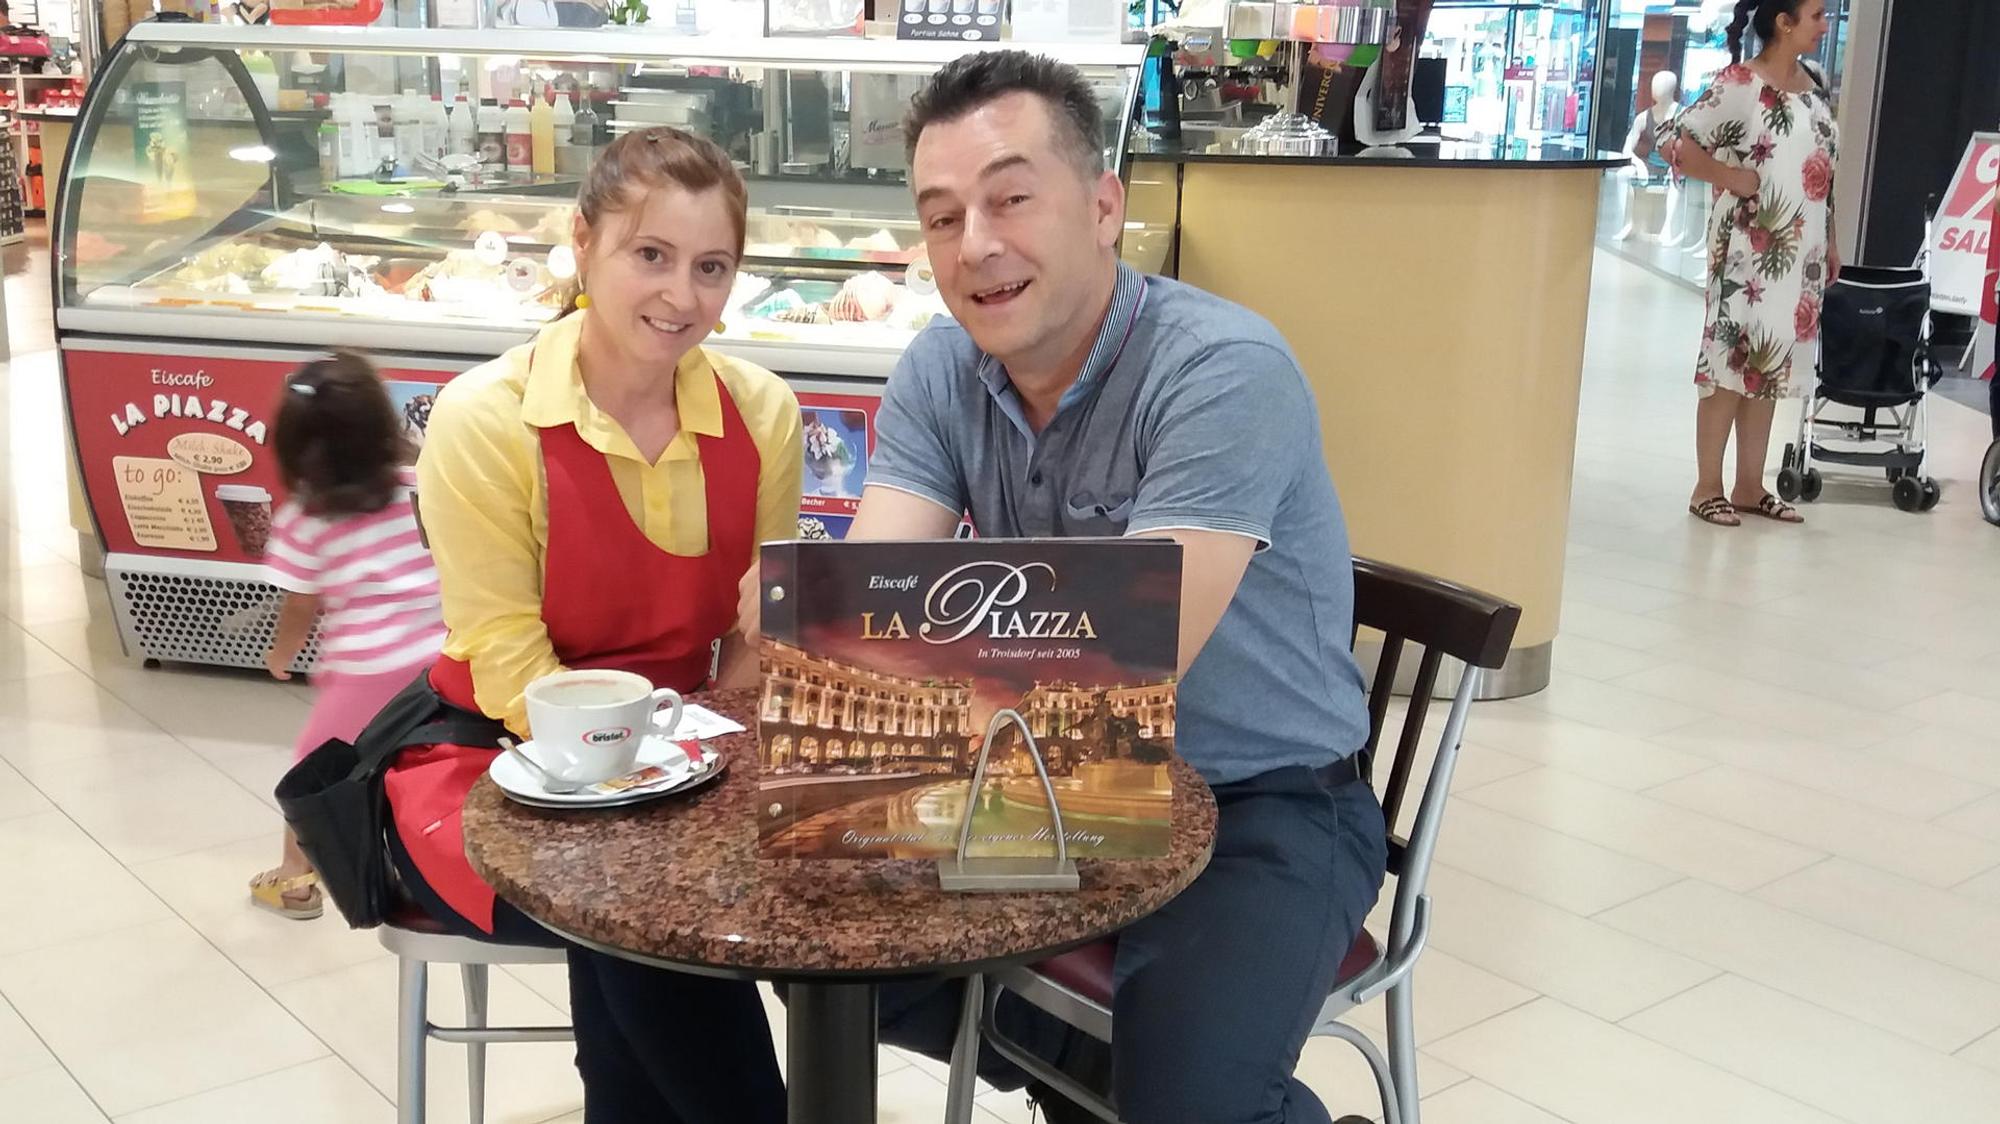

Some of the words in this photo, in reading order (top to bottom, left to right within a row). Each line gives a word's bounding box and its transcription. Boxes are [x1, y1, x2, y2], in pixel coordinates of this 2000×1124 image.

[1939, 227, 1988, 256] SAL
[151, 369, 214, 390] Eiscafe
[111, 402, 147, 436] LA
[153, 393, 267, 445] PIAZZA
[124, 464, 144, 483] to
[868, 575, 919, 591] Eiscafé
[860, 611, 910, 640] LA
[919, 560, 1098, 645] PIAZZA
[977, 648, 989, 659] In
[990, 648, 1036, 660] Troisdorf
[1037, 648, 1054, 659] seit
[1056, 648, 1081, 659] 2005
[1029, 826, 1105, 848] Hertellung
